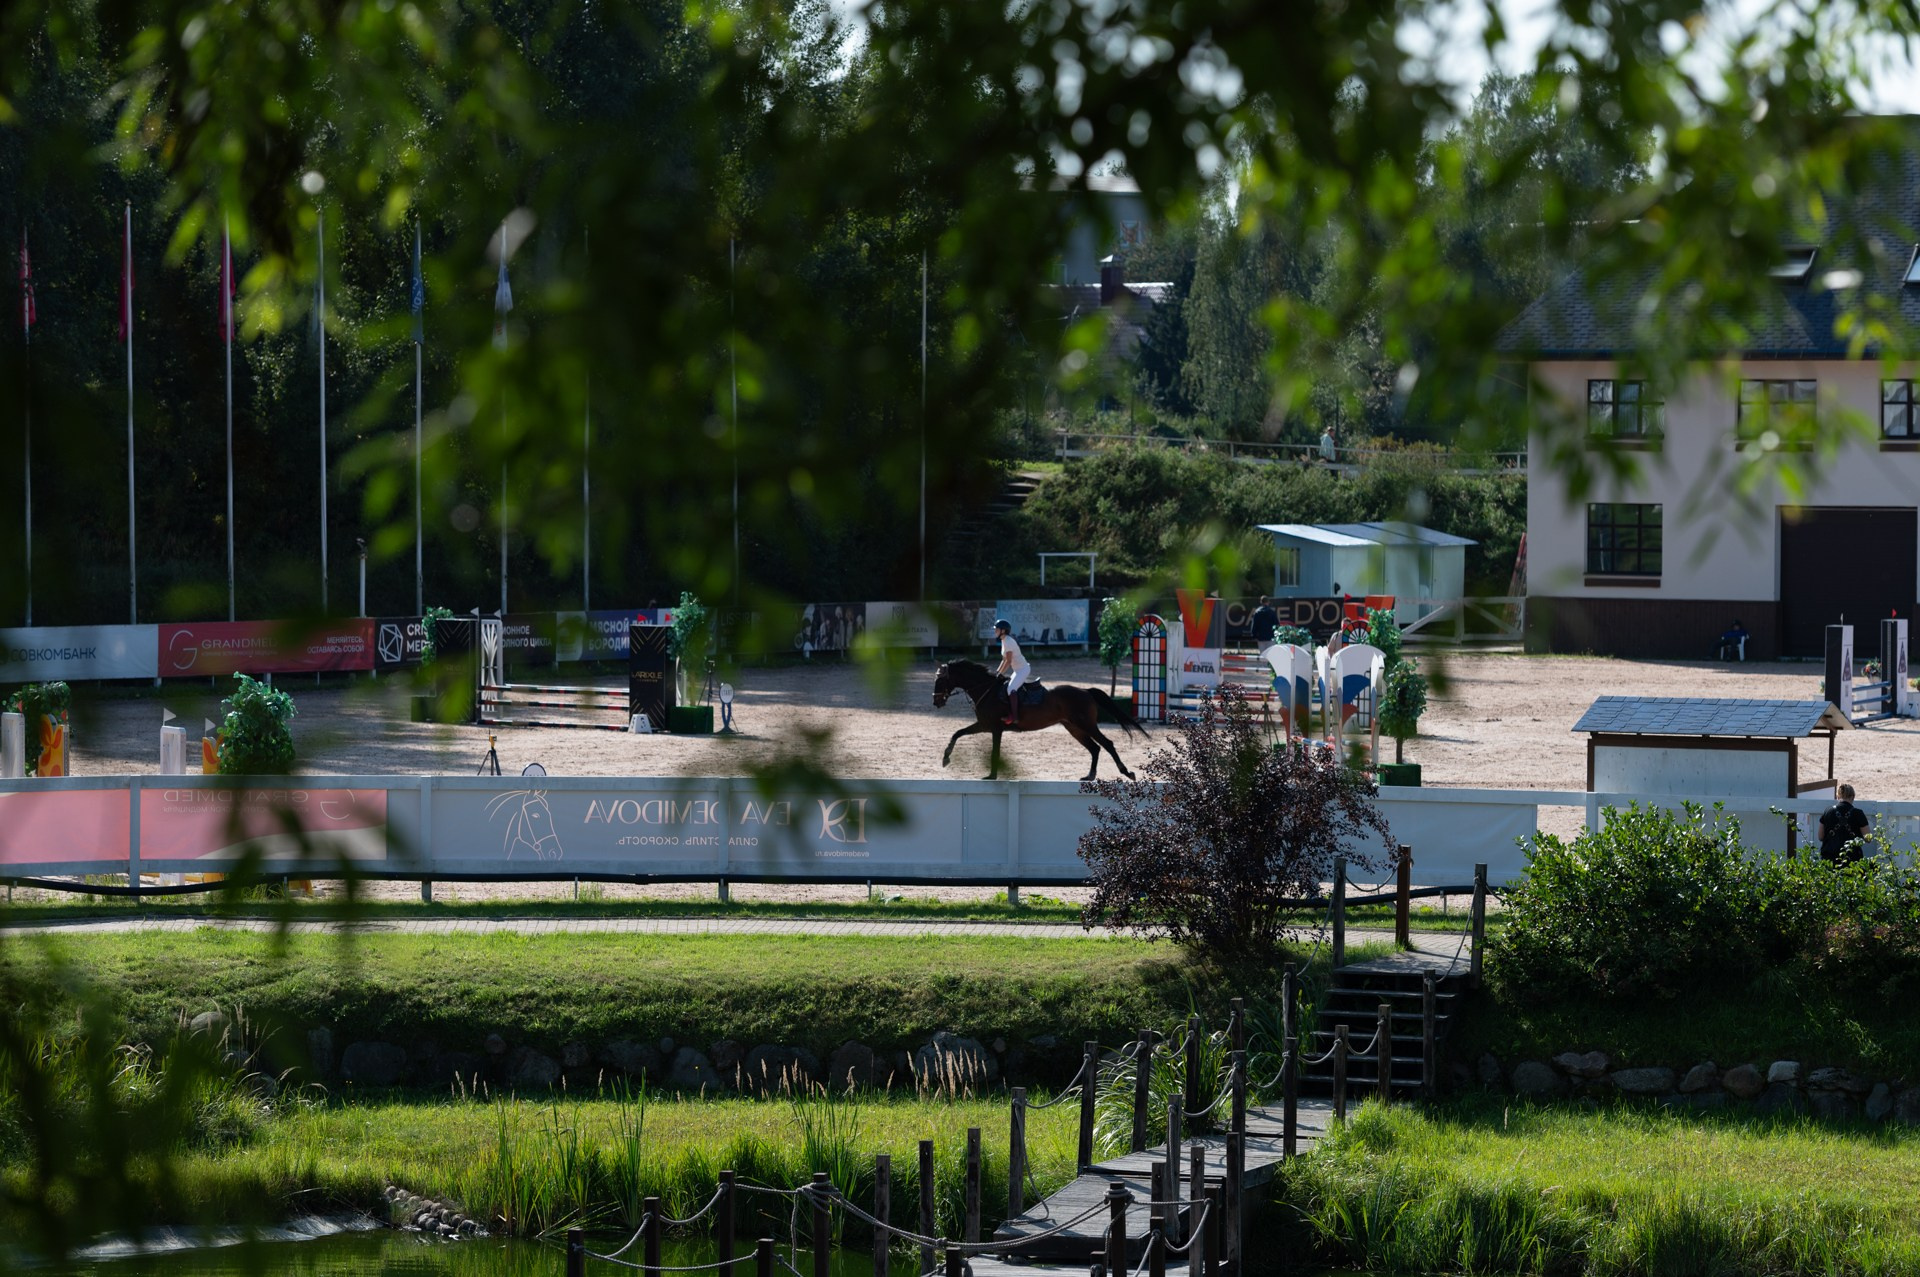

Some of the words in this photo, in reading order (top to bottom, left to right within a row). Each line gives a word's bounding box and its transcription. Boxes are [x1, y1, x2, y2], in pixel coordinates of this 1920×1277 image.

[1225, 602, 1290, 626] CE
[1294, 600, 1340, 625] D'O
[588, 636, 630, 651] БОРОДИ
[10, 647, 97, 662] СОВКОМБАНК
